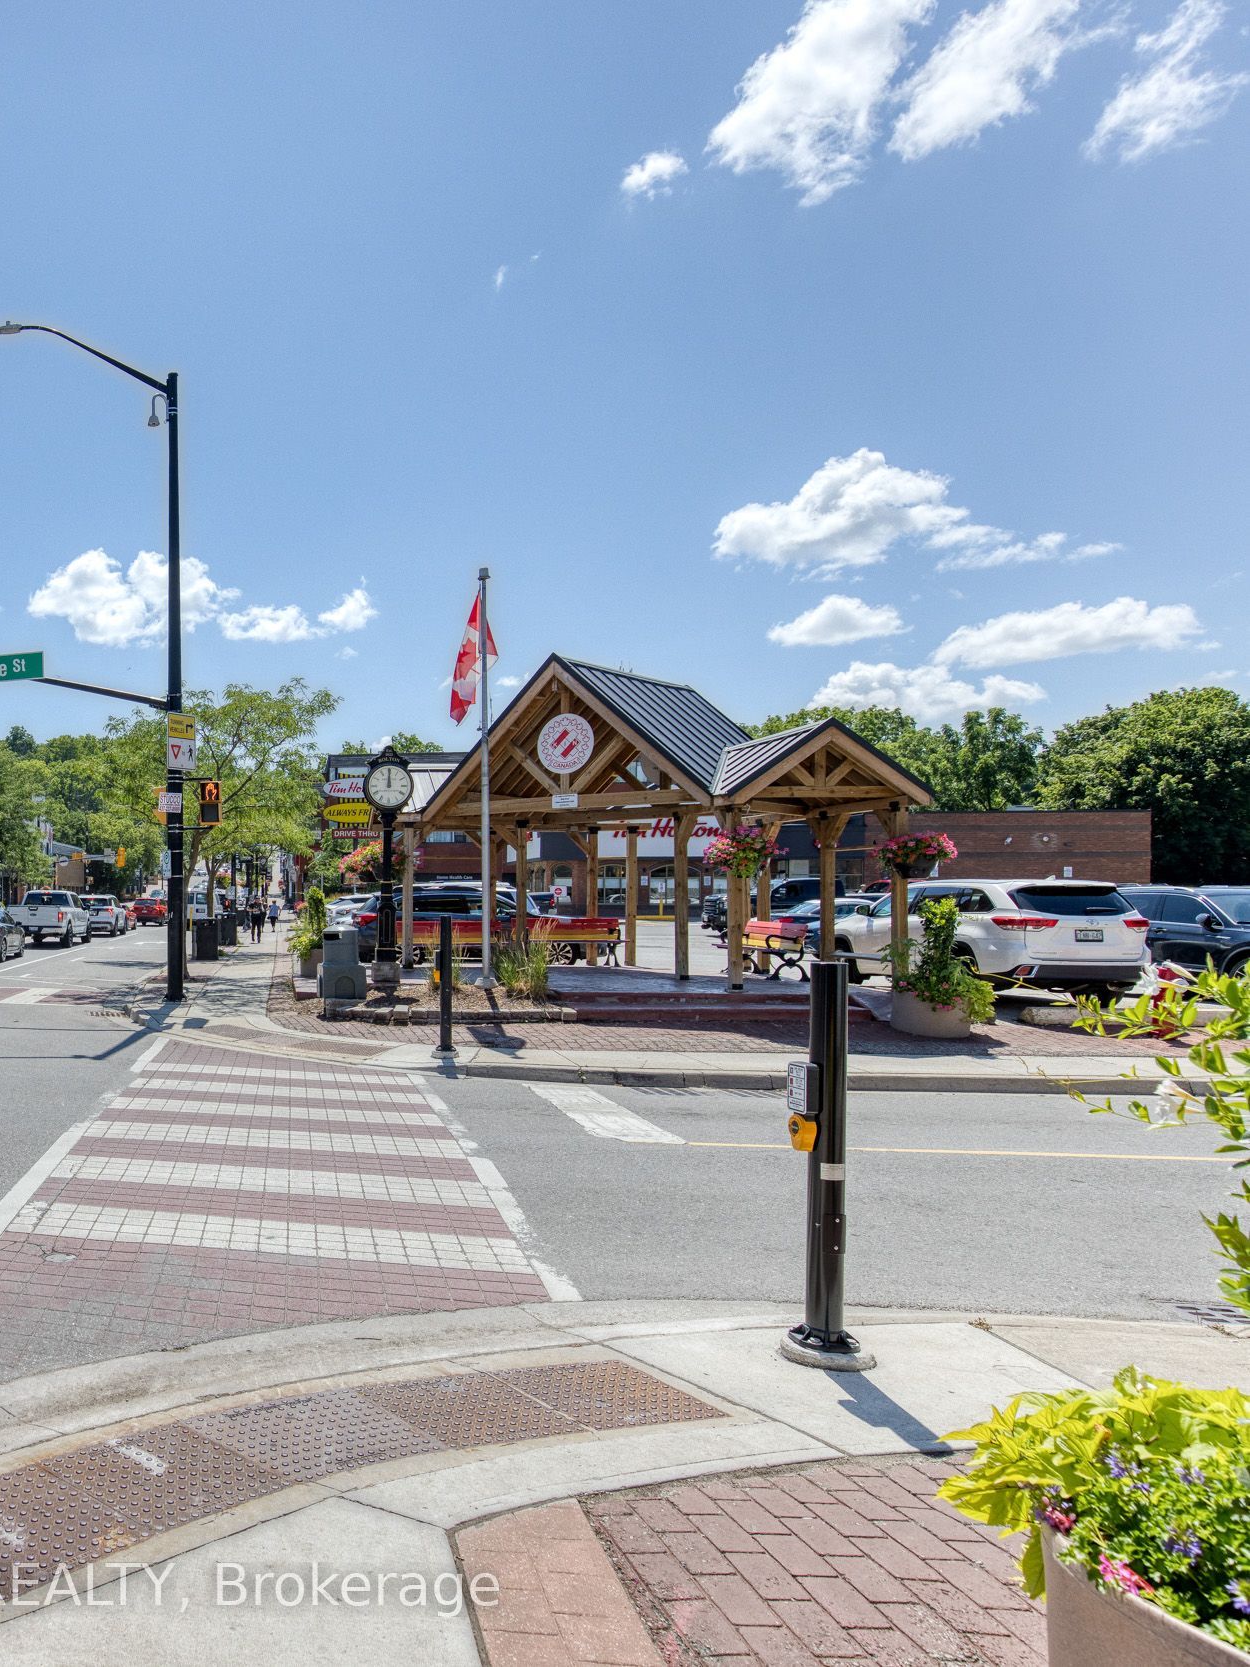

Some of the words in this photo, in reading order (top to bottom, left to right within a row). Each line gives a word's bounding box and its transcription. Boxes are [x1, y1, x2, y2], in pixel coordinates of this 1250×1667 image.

[12, 658, 26, 673] St
[553, 759, 579, 770] CANADA
[328, 782, 347, 793] Tim
[326, 808, 357, 817] ALWAYS
